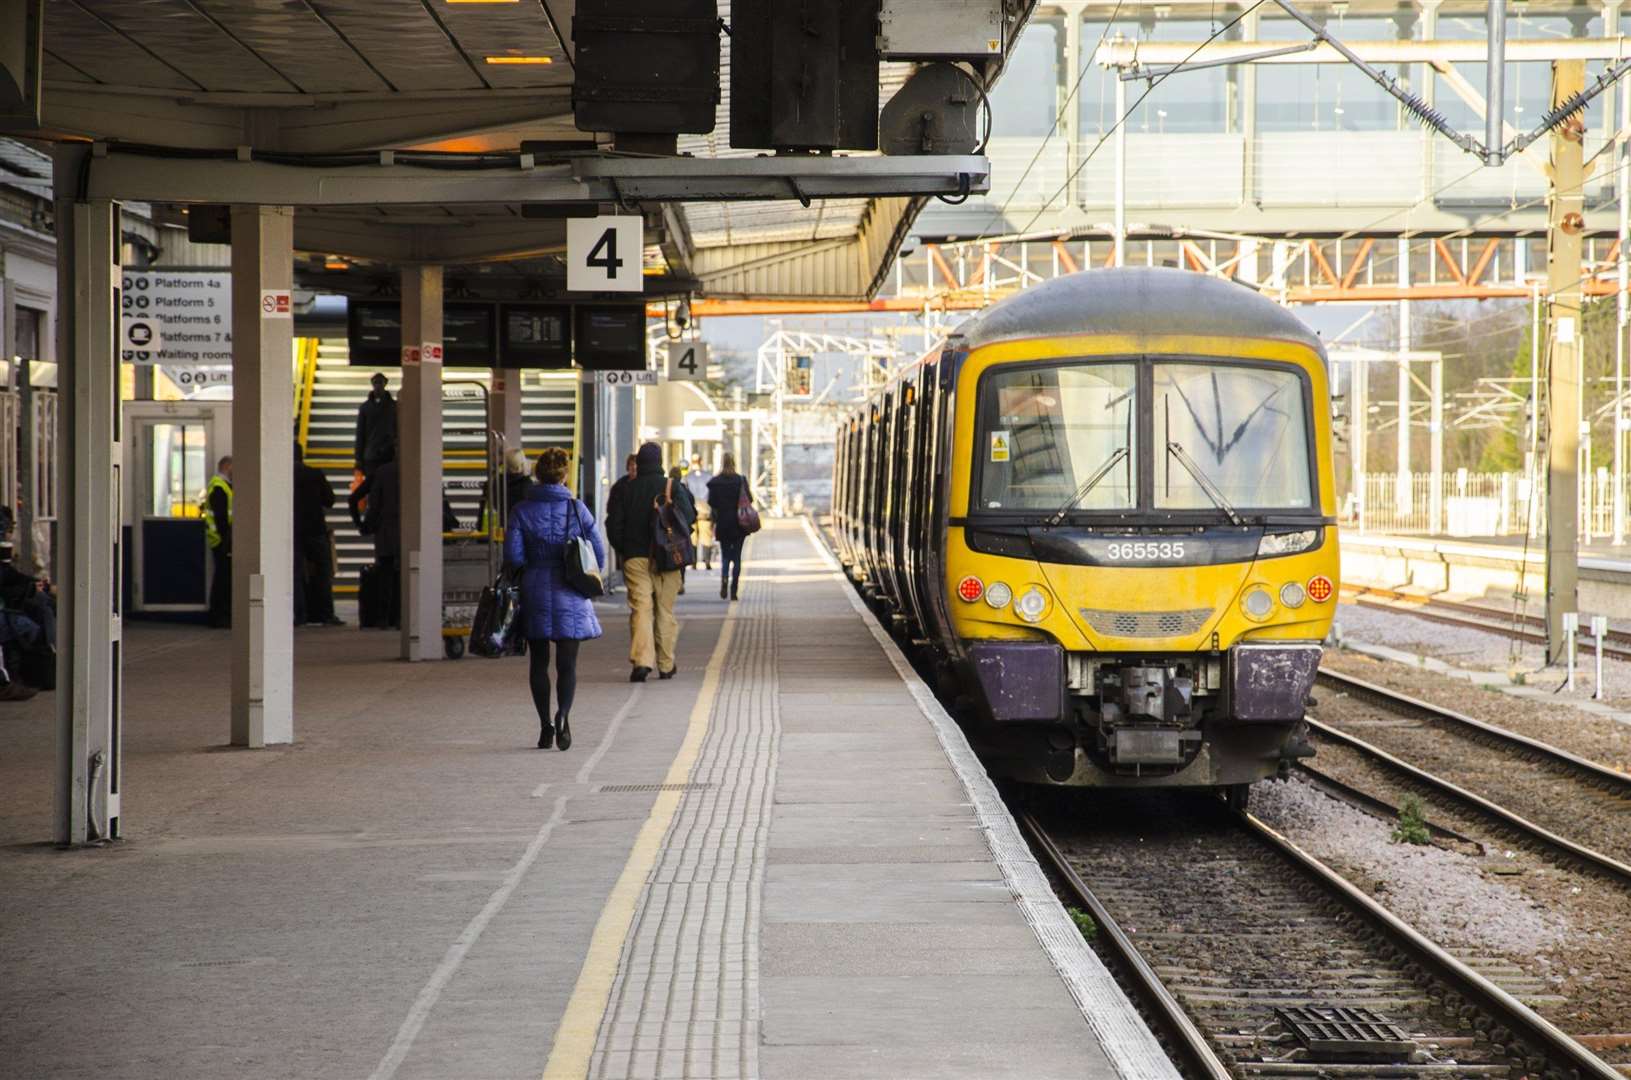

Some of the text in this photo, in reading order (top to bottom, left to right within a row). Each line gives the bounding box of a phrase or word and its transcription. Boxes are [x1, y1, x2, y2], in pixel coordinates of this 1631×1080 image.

[586, 228, 623, 279] 4
[155, 278, 221, 288] Platform 4a
[155, 296, 215, 307] Platform 5
[214, 315, 221, 324] 6
[214, 333, 221, 342] 7
[157, 350, 199, 361] Waiting
[678, 348, 698, 375] 4
[210, 372, 227, 382] Lift
[636, 373, 653, 382] Lift
[1108, 542, 1185, 560] 365535
